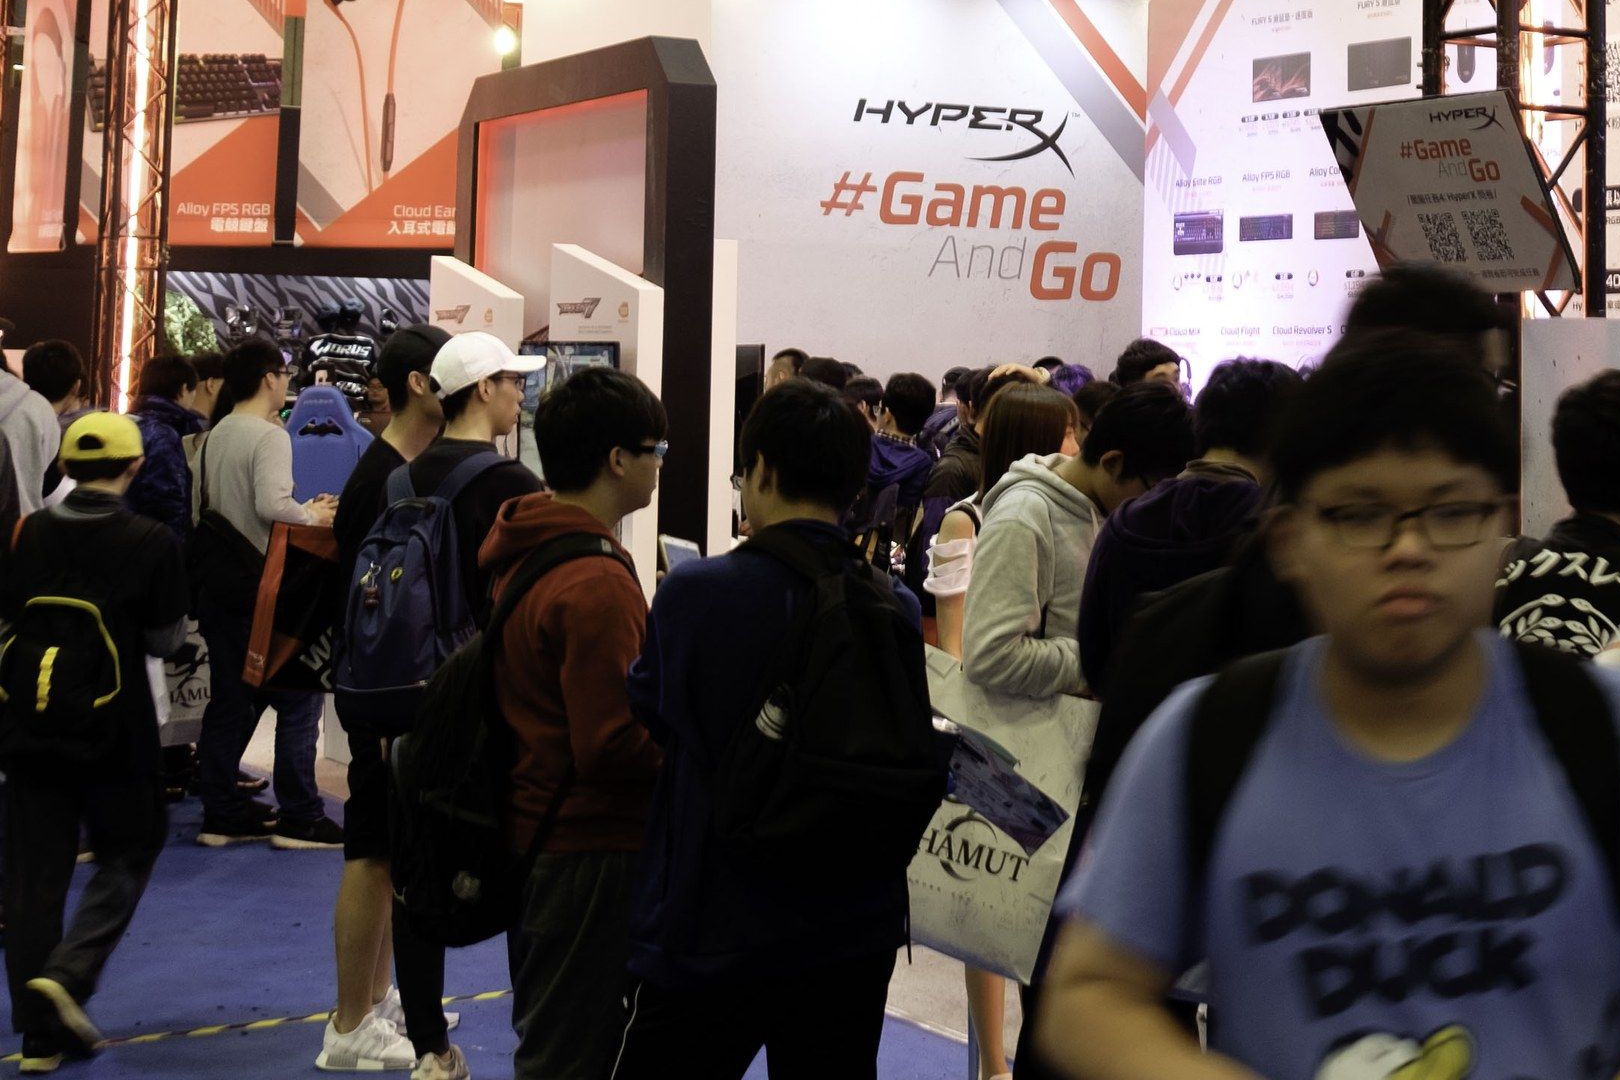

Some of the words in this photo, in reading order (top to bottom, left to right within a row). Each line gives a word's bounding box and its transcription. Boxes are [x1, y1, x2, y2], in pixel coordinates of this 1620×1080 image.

[853, 98, 1076, 178] HYPERX
[1429, 104, 1506, 133] HYPERX
[1400, 137, 1472, 160] #Game
[177, 203, 209, 217] Alloy
[212, 203, 239, 216] FPS
[242, 203, 270, 215] RGB
[394, 205, 431, 217] Cloud
[820, 170, 1065, 231] #Game
[1029, 241, 1122, 301] Go
[1273, 326, 1292, 336] Cloud
[1239, 843, 1572, 945] DONALD
[1297, 925, 1539, 1017] DUCK
